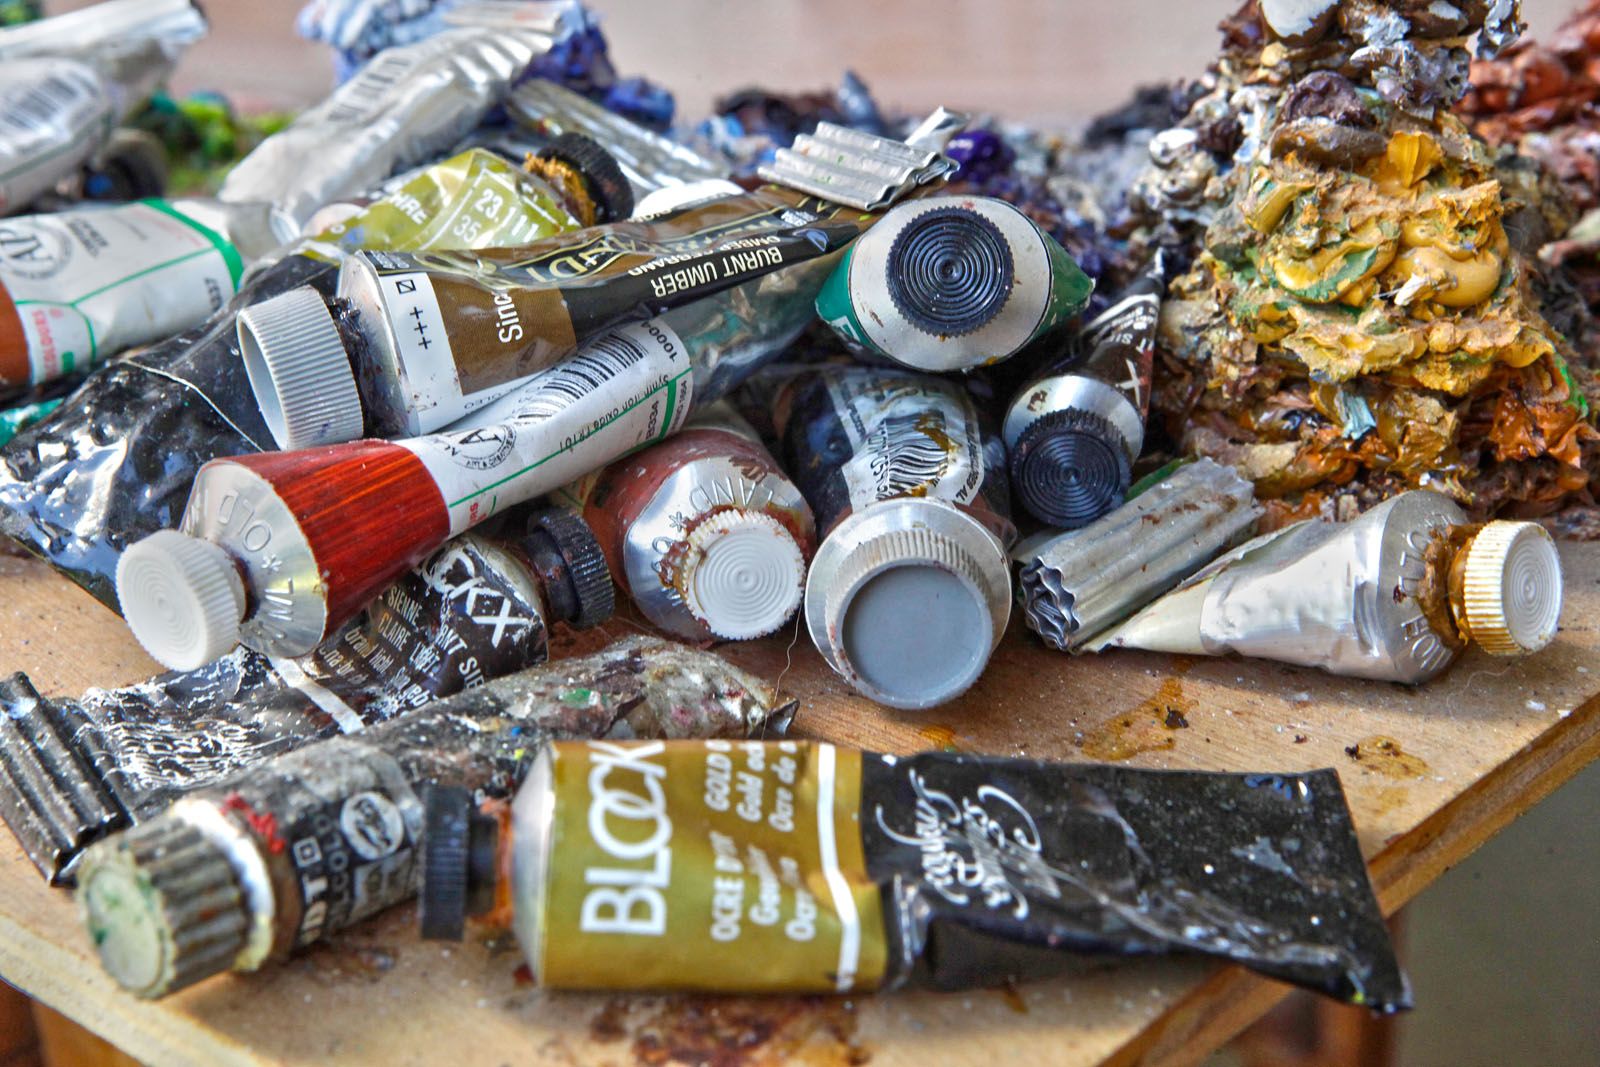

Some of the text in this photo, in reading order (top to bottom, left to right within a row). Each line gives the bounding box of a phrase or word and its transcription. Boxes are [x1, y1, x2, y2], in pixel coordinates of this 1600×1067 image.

[650, 246, 783, 298] BURNT UMBER
[493, 288, 523, 343] Sinc
[704, 753, 733, 812] GOLD
